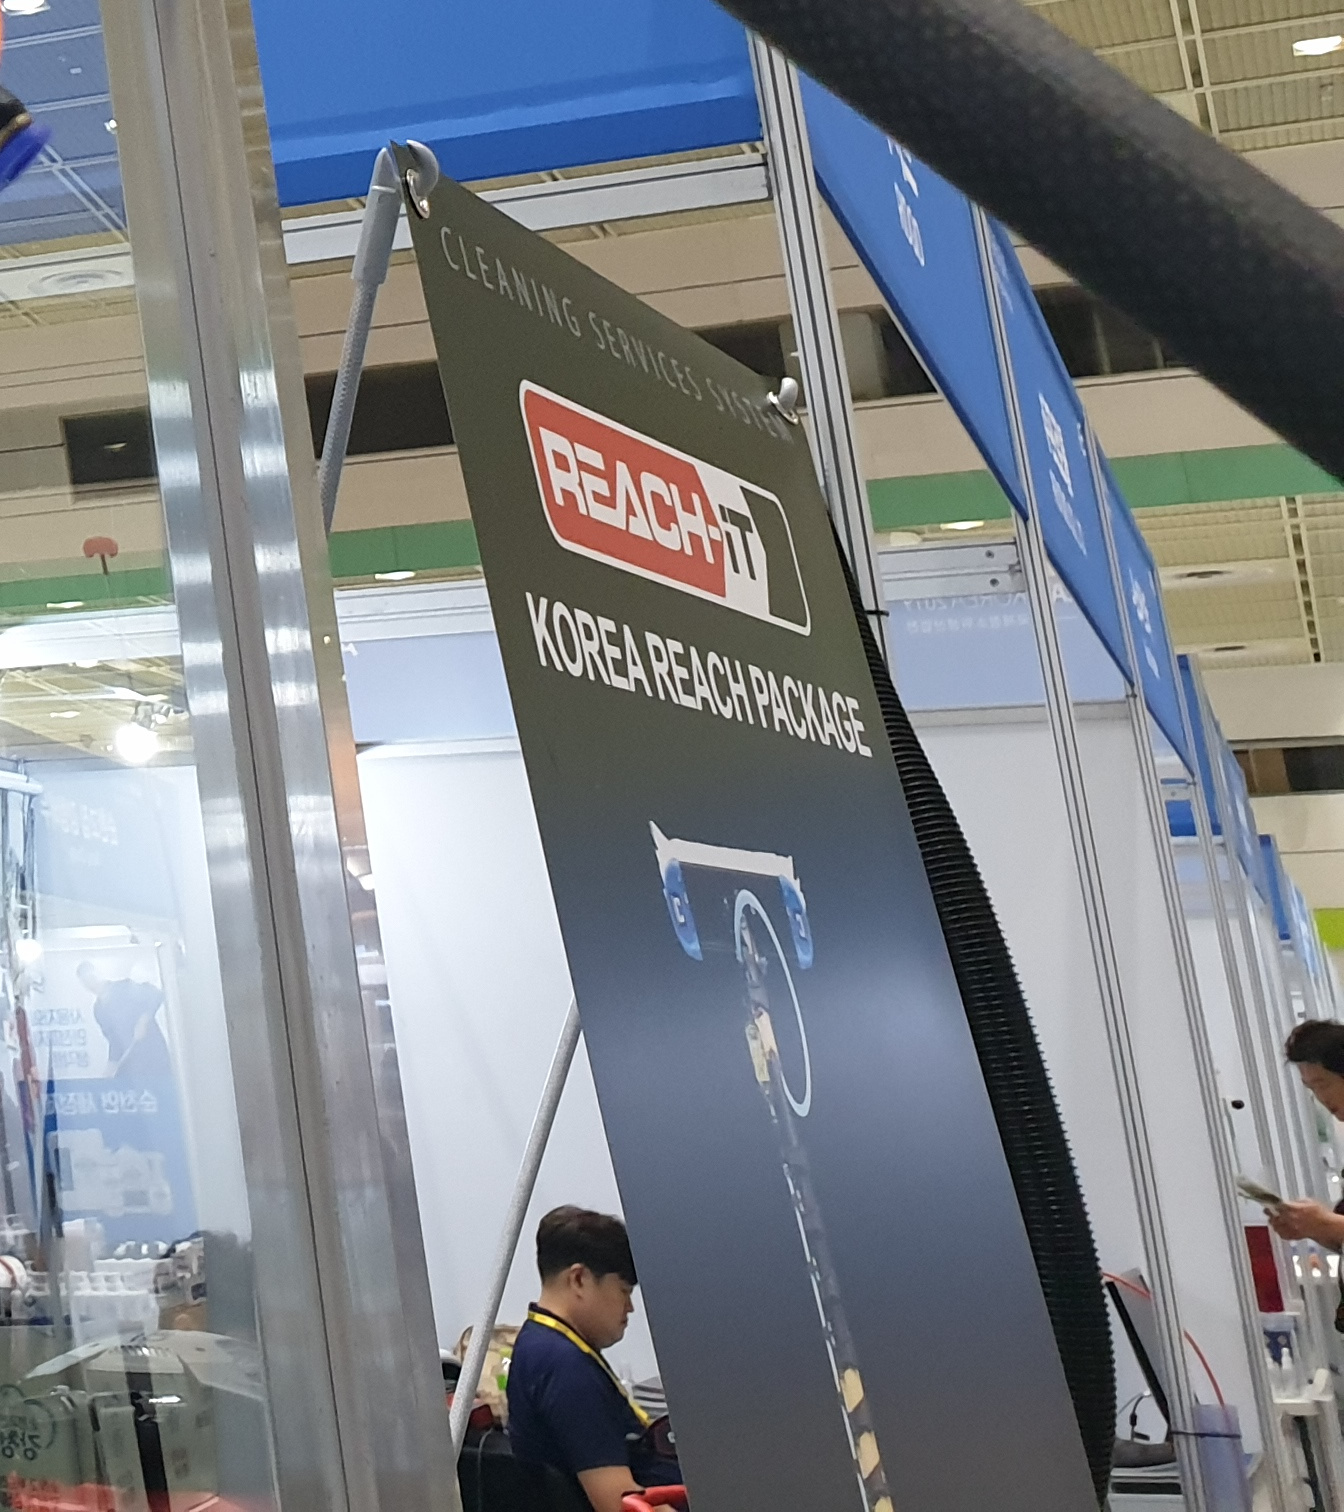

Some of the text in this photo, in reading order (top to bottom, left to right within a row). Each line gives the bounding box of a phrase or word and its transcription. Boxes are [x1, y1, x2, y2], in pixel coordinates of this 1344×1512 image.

[440, 225, 582, 338] CLEANING
[588, 310, 702, 402] SERVICES
[525, 591, 873, 759] KOREA REACH PACKAGE
